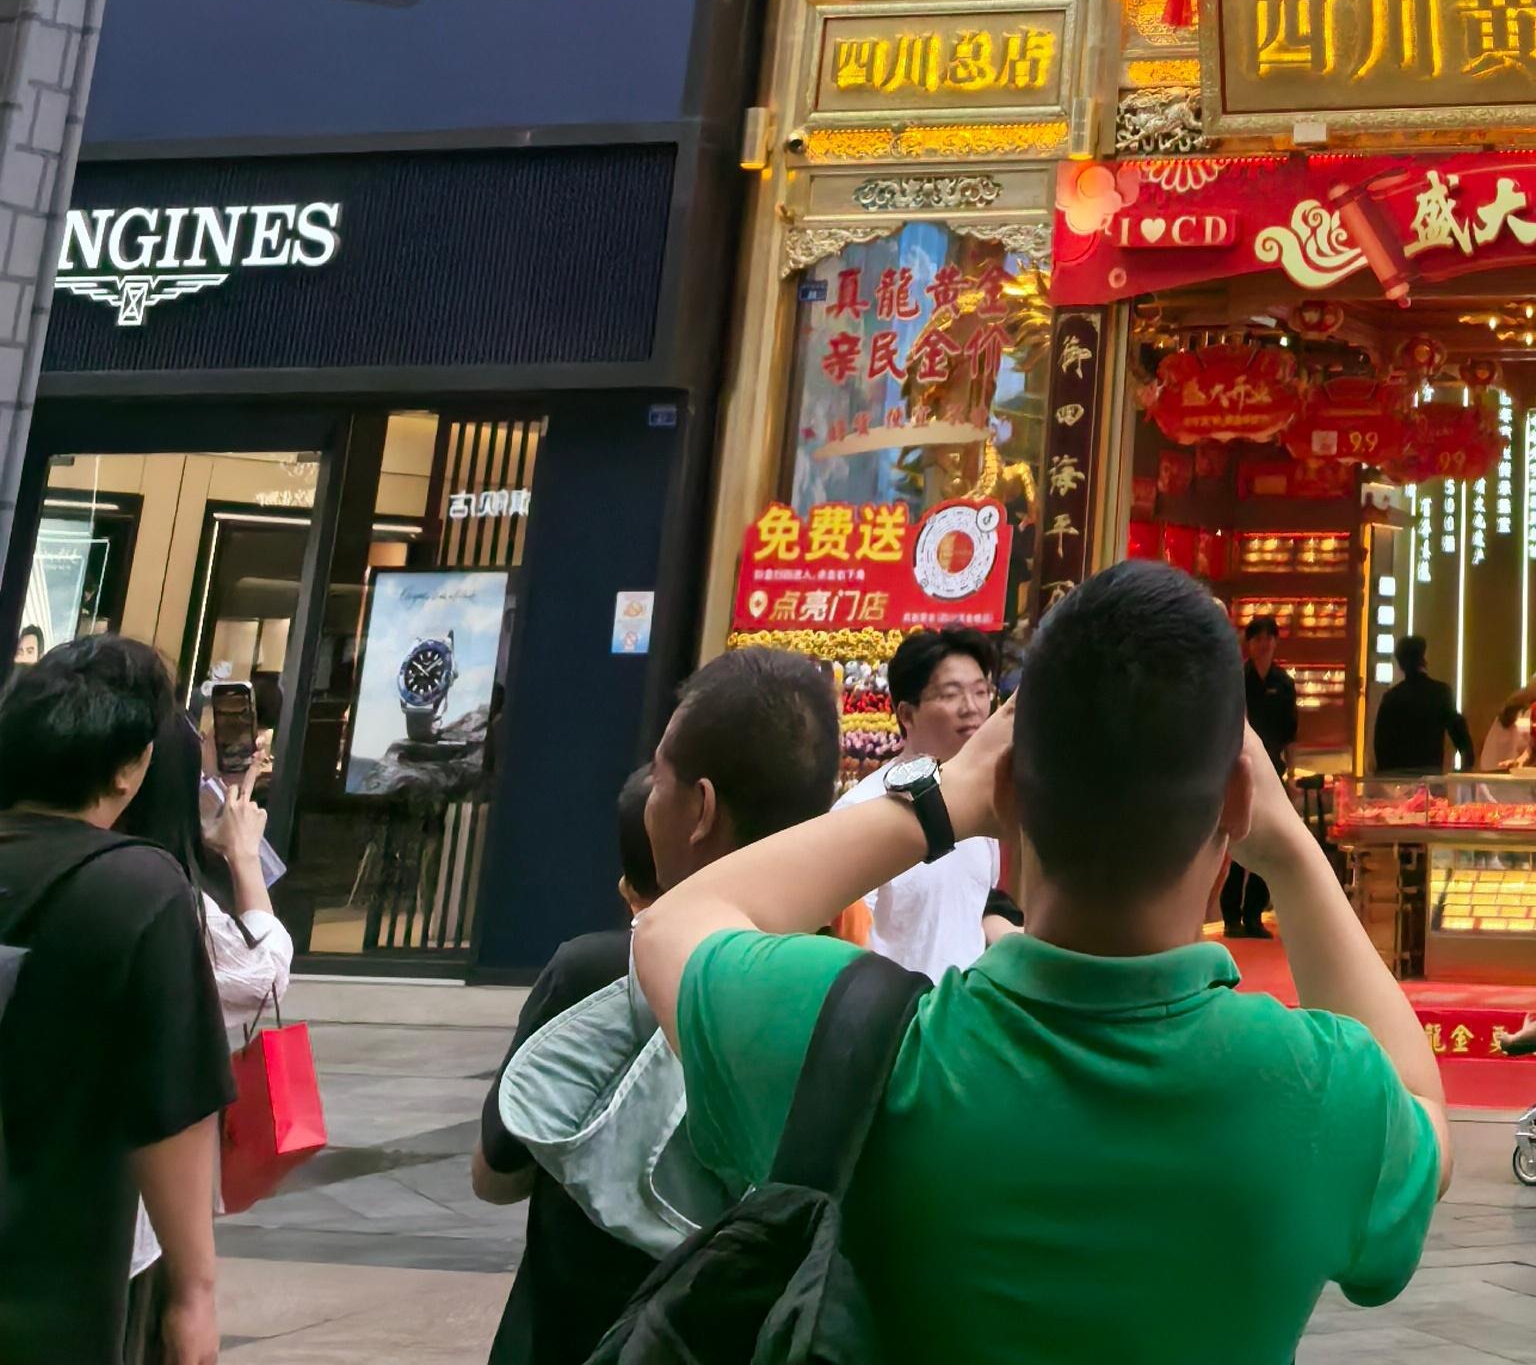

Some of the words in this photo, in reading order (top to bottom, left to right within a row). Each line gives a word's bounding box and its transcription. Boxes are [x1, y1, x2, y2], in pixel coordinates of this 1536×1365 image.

[835, 26, 1057, 93] 四川总店
[57, 202, 342, 269] NGINES
[754, 506, 907, 562] 免费送
[769, 590, 890, 622] 点亮门店
